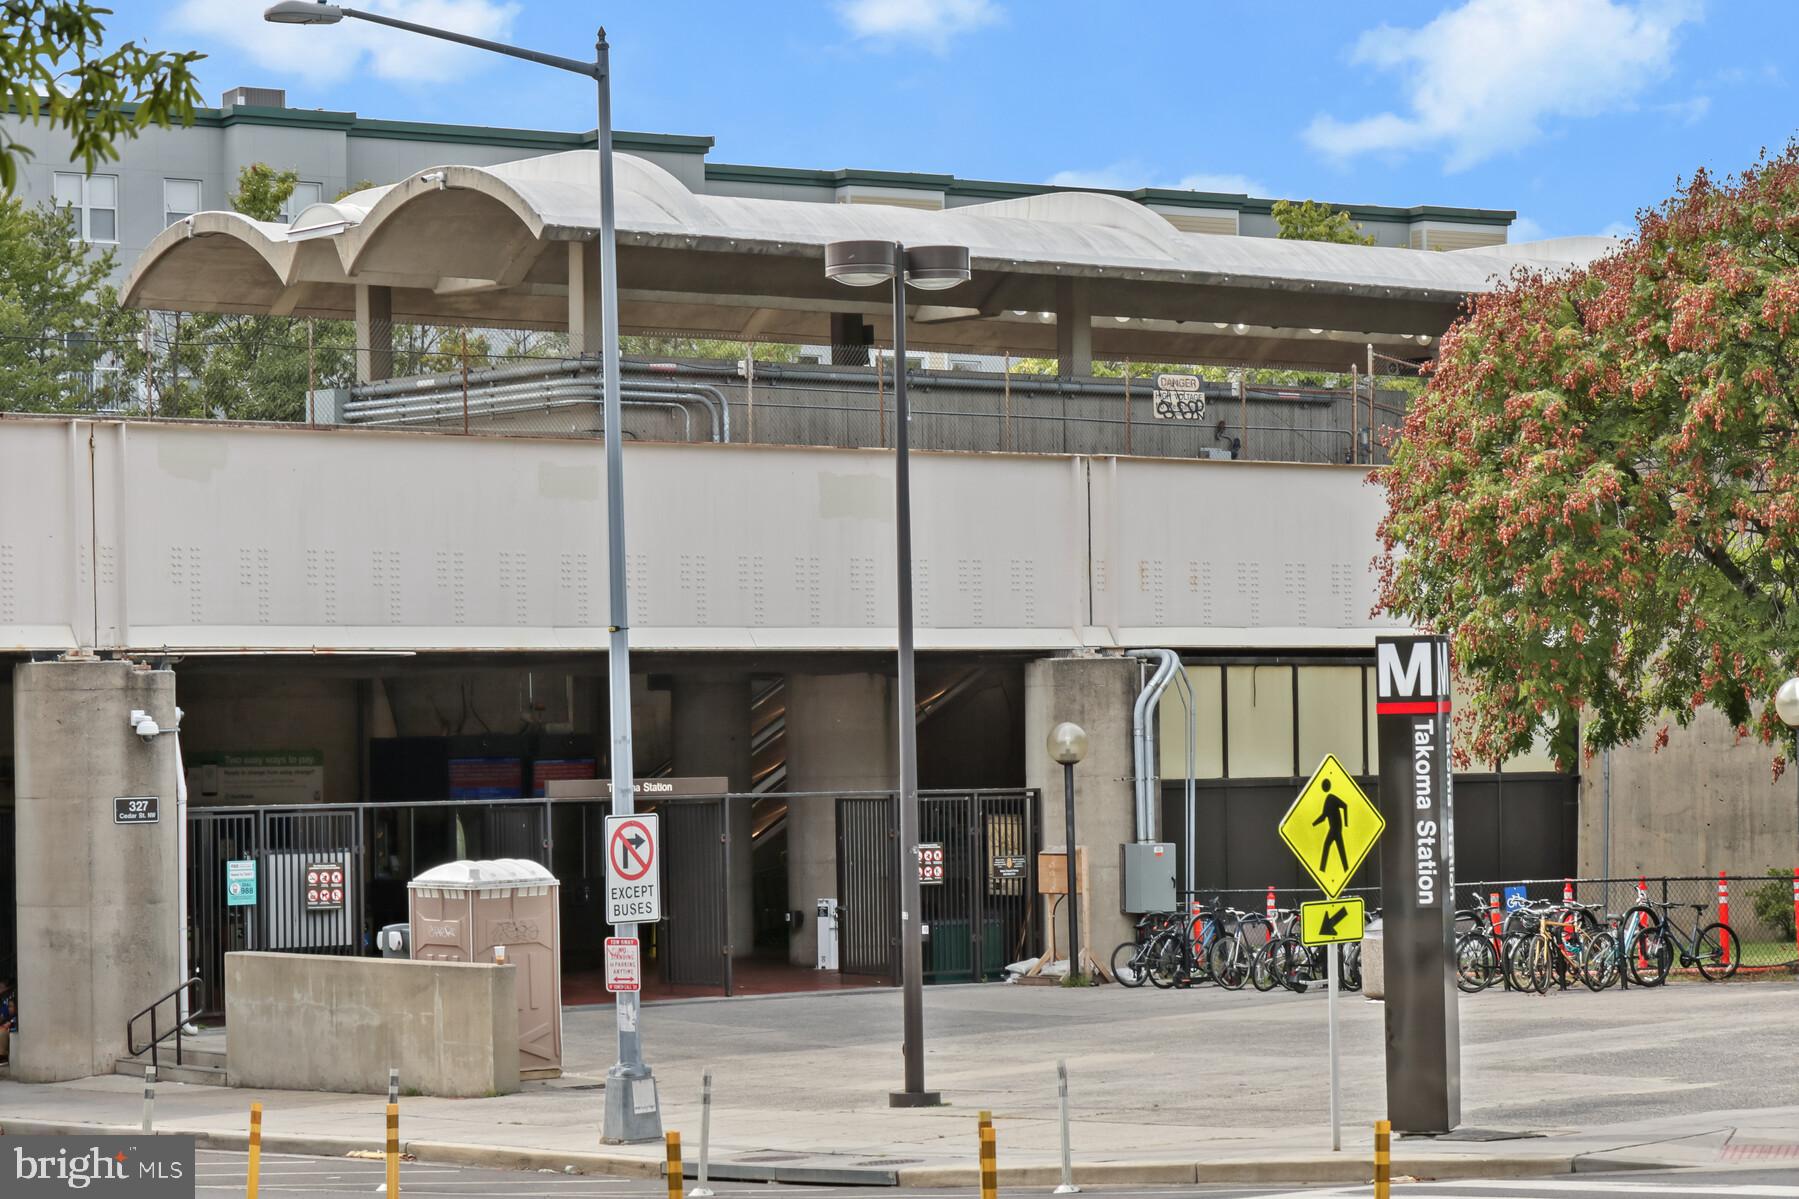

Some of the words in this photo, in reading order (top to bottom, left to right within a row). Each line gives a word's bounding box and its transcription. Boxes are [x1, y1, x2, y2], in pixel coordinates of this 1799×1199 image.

[1160, 378, 1197, 388] DANGER
[1378, 642, 1433, 697] M
[1414, 719, 1434, 809] Takoma
[643, 782, 673, 792] Station
[129, 801, 148, 811] 327
[1416, 820, 1437, 904] Station
[240, 887, 254, 895] 988
[611, 884, 654, 900] EXCEPT
[614, 901, 653, 917] BUSES
